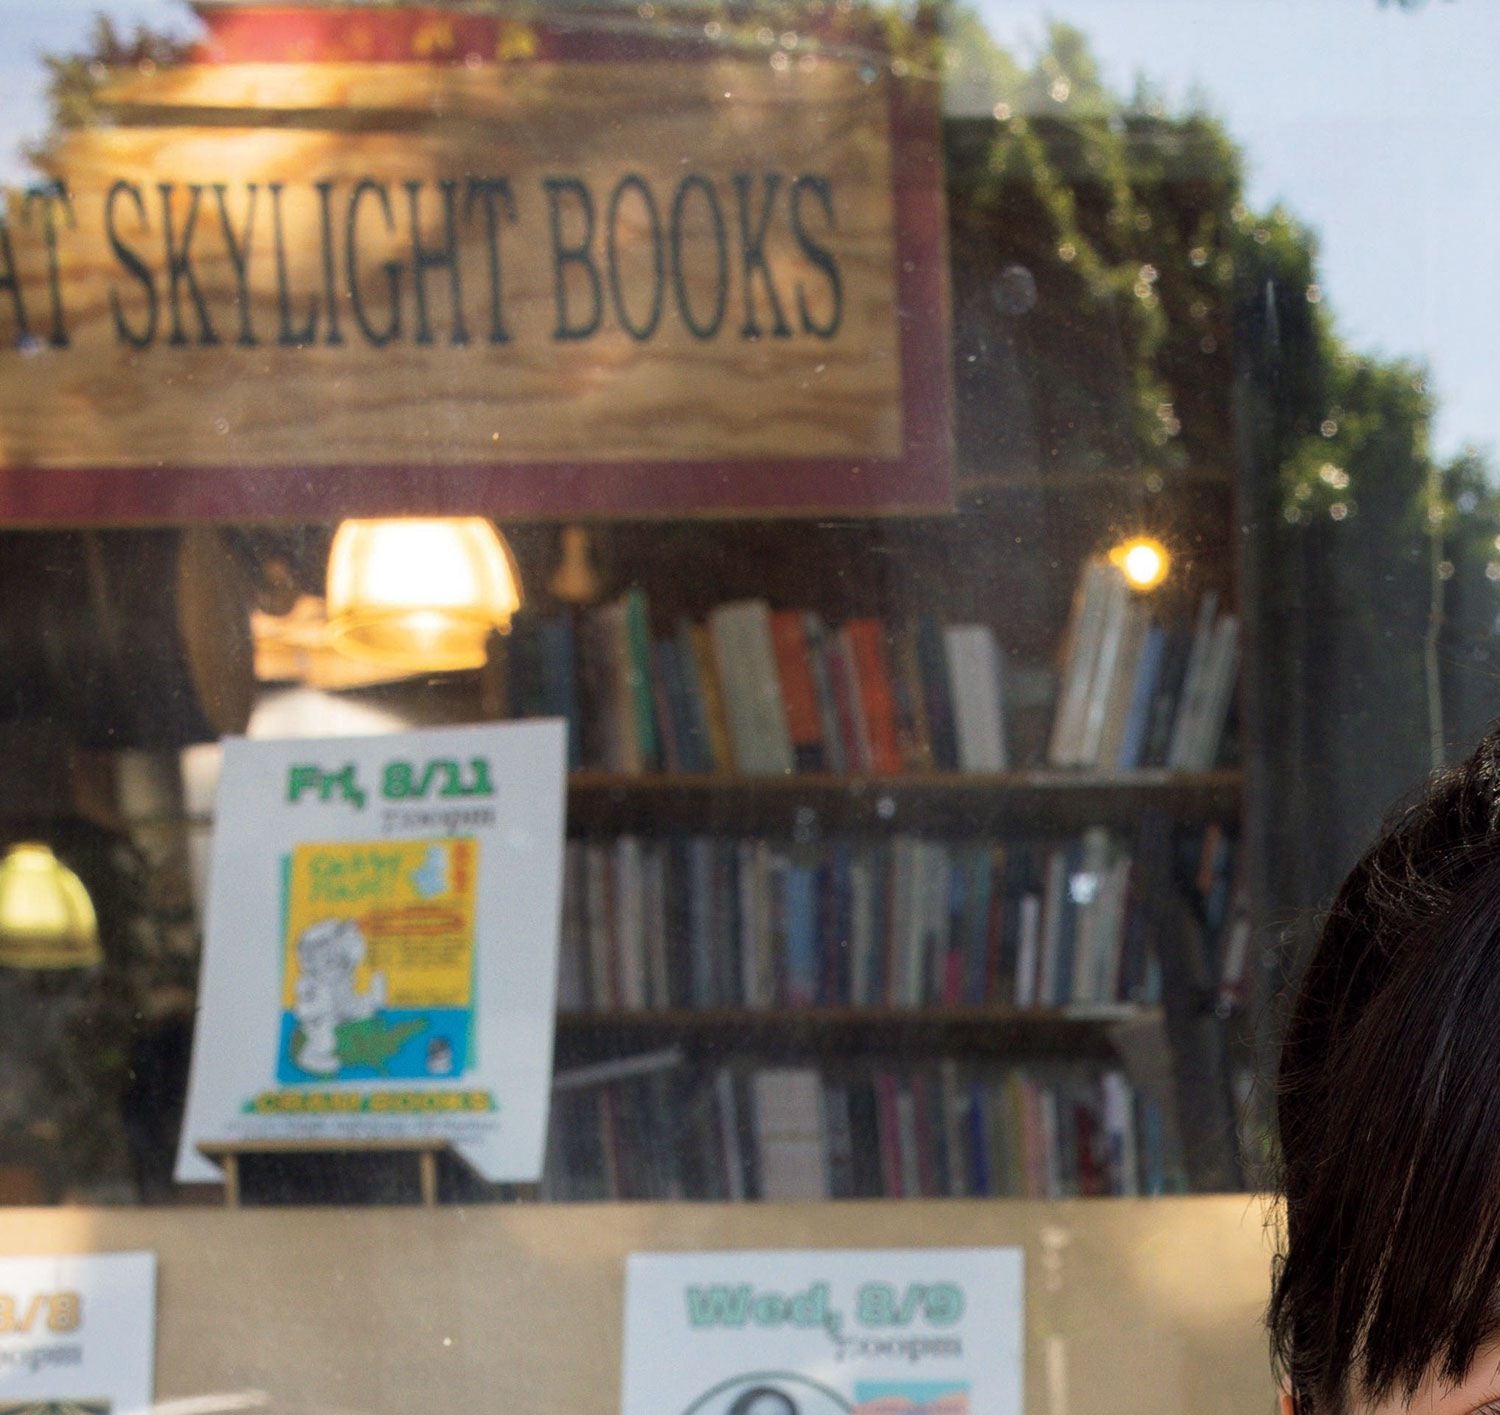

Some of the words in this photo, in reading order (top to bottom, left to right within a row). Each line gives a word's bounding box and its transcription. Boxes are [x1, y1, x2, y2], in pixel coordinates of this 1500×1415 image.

[104, 174, 520, 350] SKYLIGHT
[542, 172, 848, 341] BOOKS
[382, 756, 495, 799] 8/11
[856, 1281, 967, 1328] 8/9
